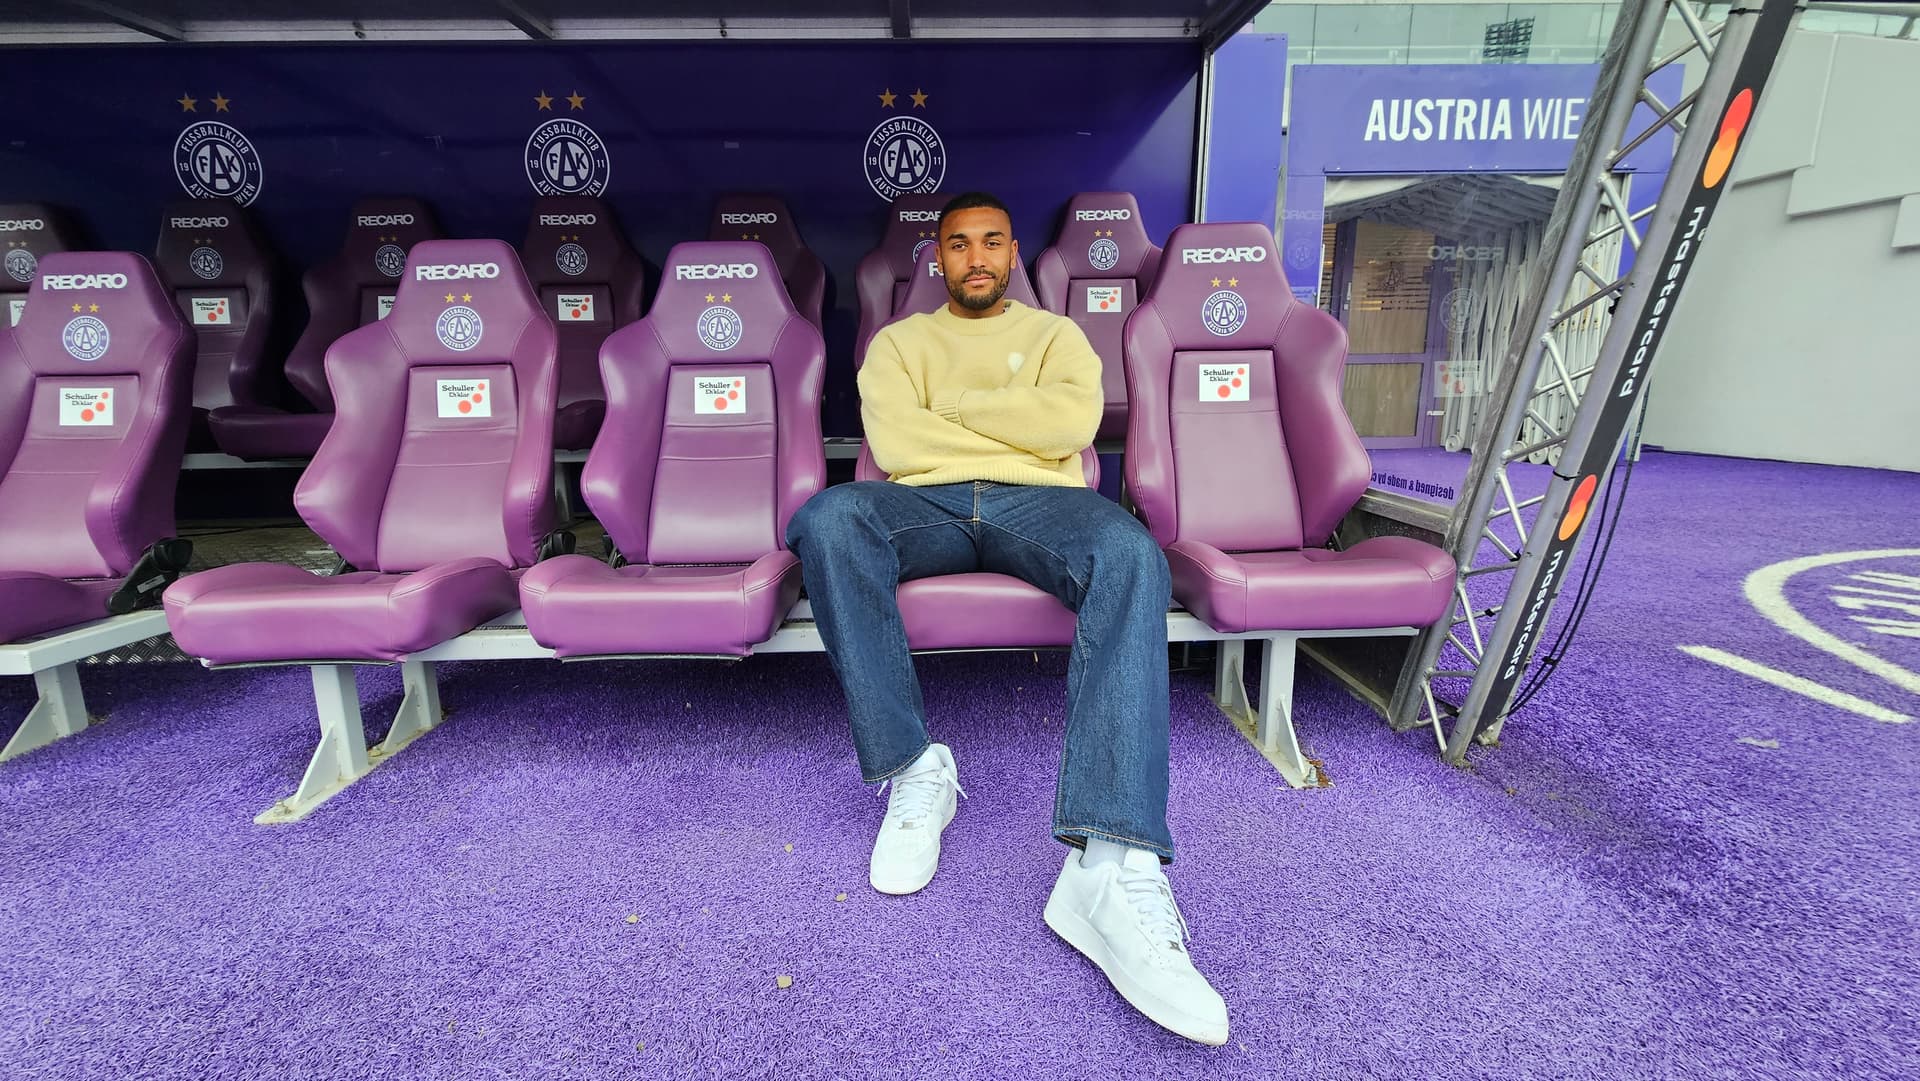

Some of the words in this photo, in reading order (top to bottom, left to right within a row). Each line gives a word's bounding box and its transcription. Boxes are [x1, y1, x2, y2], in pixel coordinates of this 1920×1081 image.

[1363, 98, 1513, 142] AUSTRIA
[1522, 97, 1591, 141] WIE
[181, 125, 249, 154] FUSSBALLKLUB
[533, 123, 600, 151] FUSSBALLKLUB
[873, 120, 938, 149] FUSSBALLKLUB
[179, 162, 190, 172] 19
[248, 162, 257, 171] 11
[529, 159, 539, 169] 19
[596, 159, 605, 169] 11
[868, 156, 878, 166] 19
[933, 156, 941, 166] 11
[233, 182, 256, 204] WIEN
[874, 176, 909, 198] AUST
[357, 214, 414, 226] RECARO
[540, 214, 597, 225] RECARO
[721, 212, 777, 224] RECARO
[899, 211, 941, 222] RECAR
[1076, 209, 1131, 221] RECARO
[0, 219, 44, 231] ECARO
[171, 216, 229, 228] RECARO
[1182, 246, 1267, 265] RECARO
[415, 263, 500, 281] RECARO
[675, 263, 759, 281] RECARO
[43, 273, 128, 290] RECARO
[1619, 206, 1706, 398] mastercard
[1503, 549, 1564, 680] mastercard
